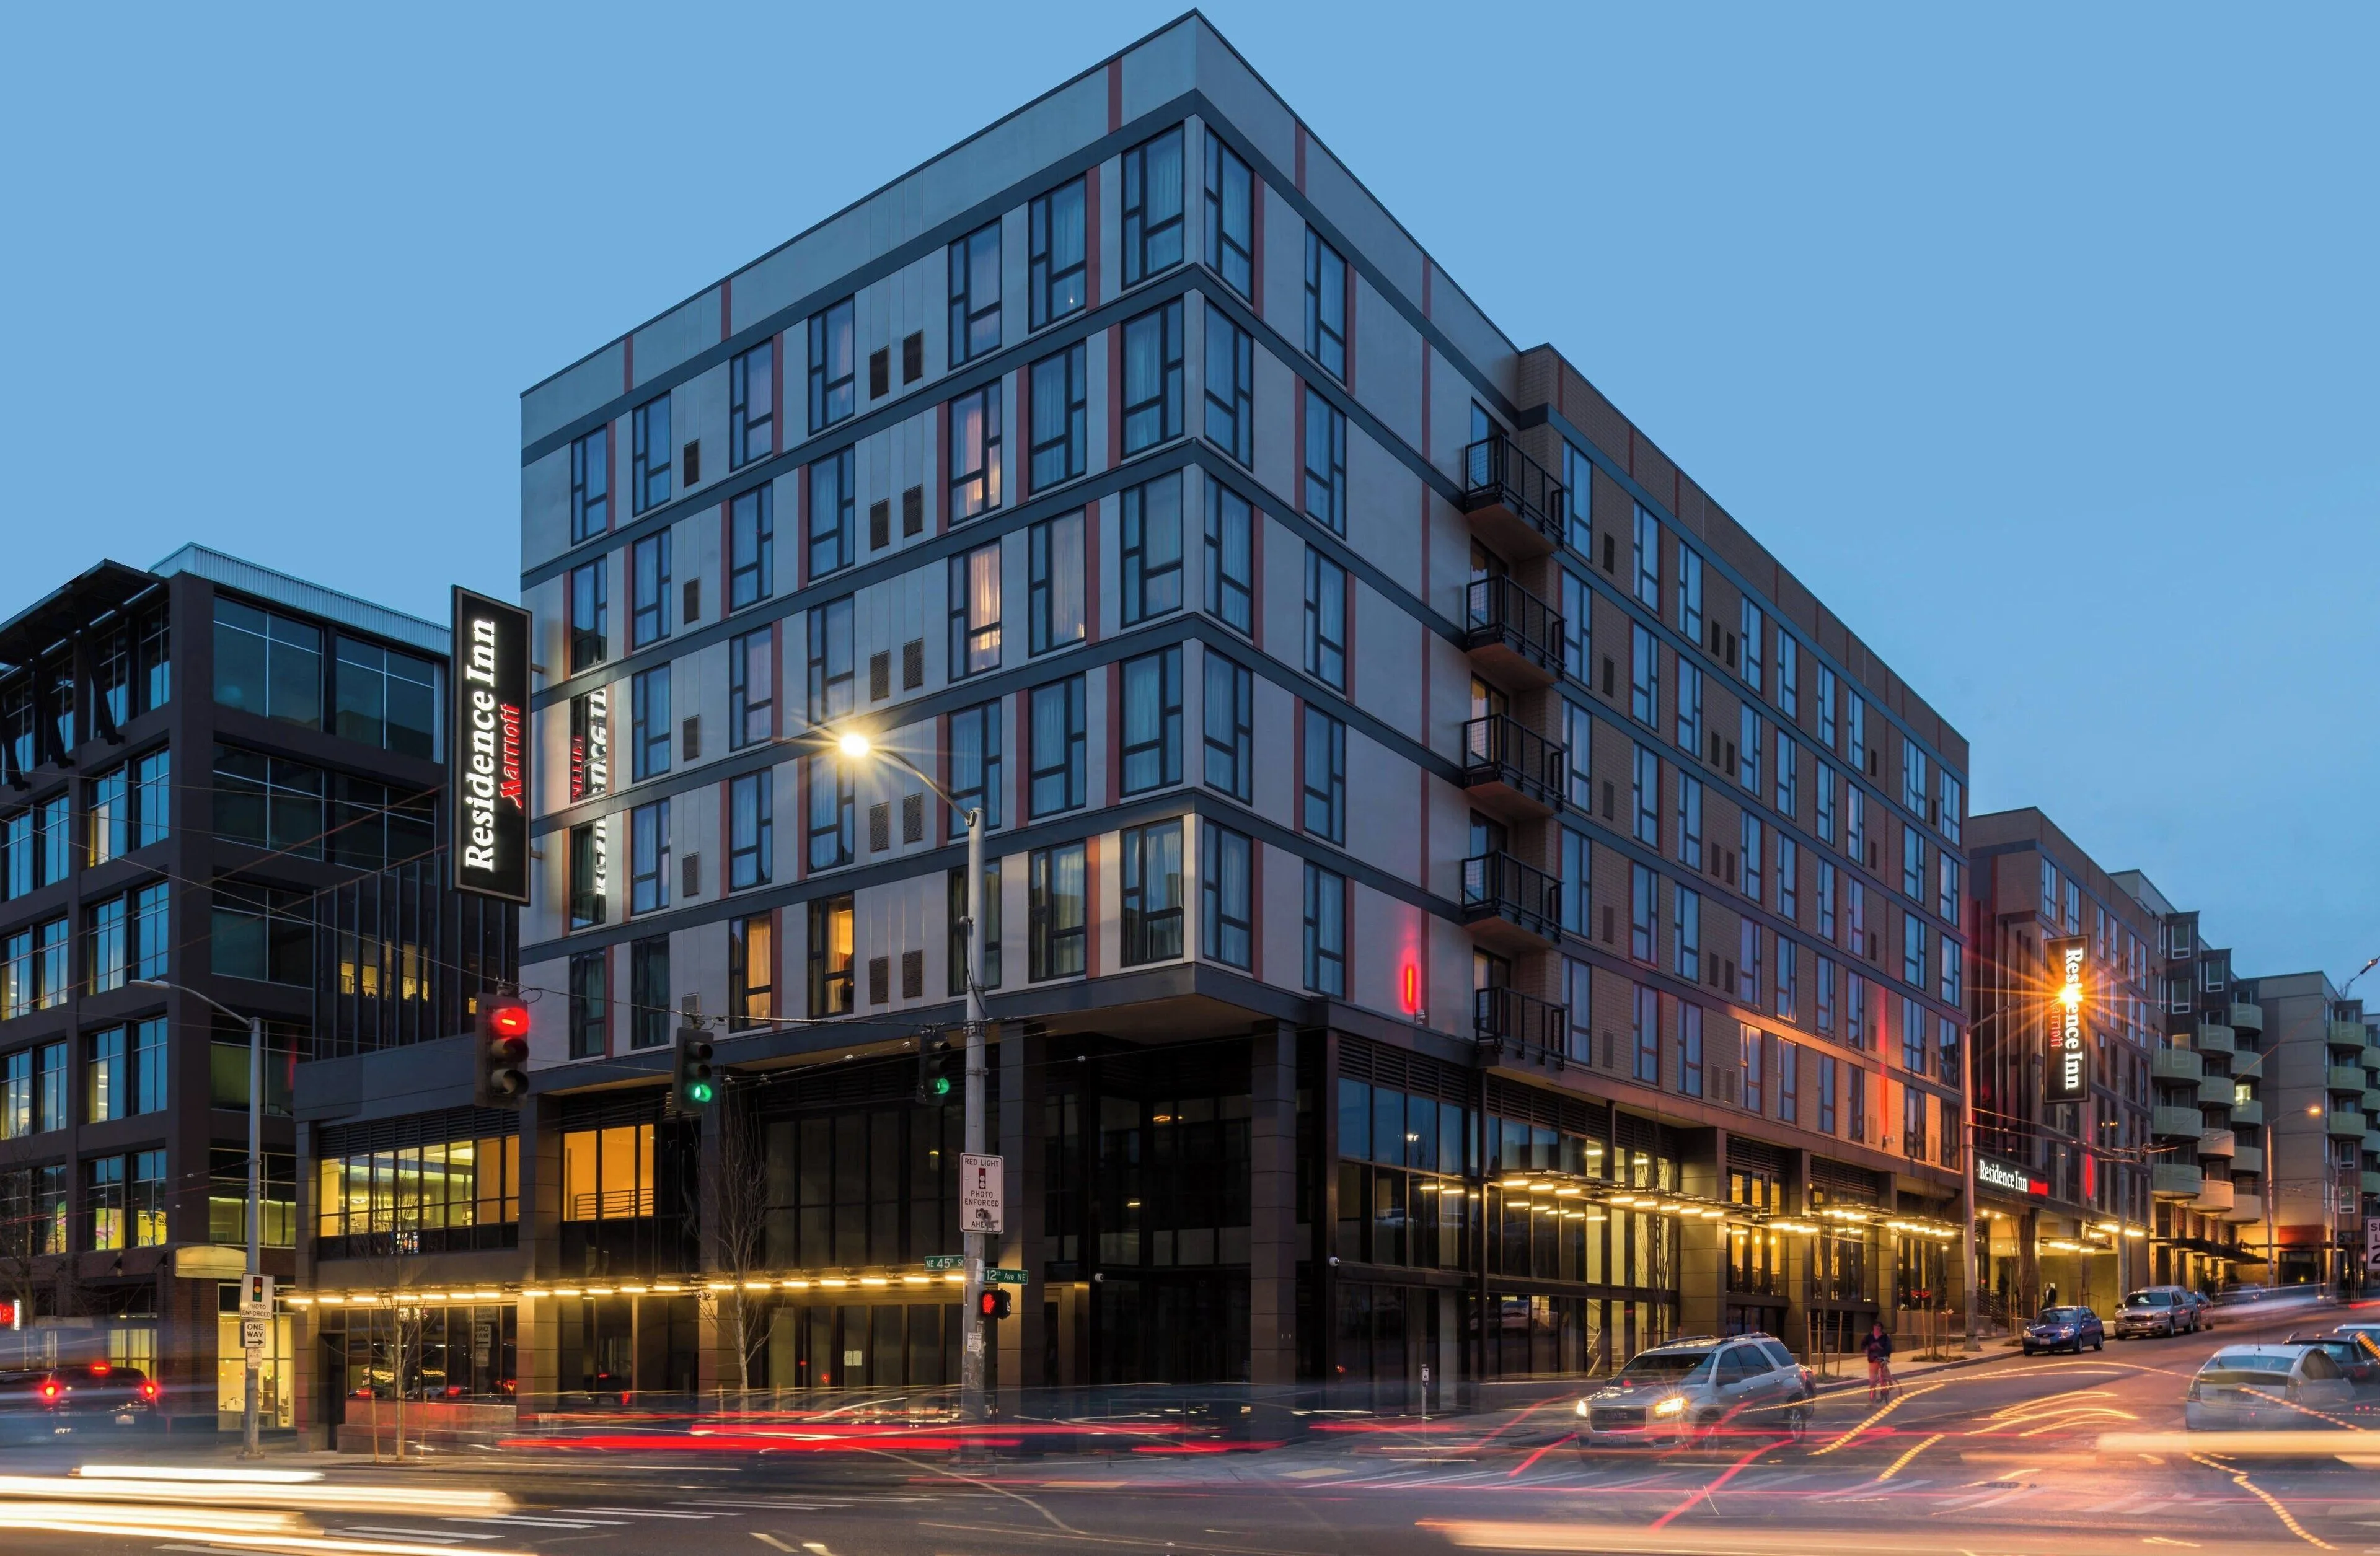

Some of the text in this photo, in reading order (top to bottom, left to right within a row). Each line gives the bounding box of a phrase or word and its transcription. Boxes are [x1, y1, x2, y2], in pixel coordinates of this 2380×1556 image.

[465, 618, 496, 872] Residence Inn
[500, 702, 522, 809] Marriott
[2065, 947, 2083, 1091] Resence Inn
[964, 1158, 977, 1166] RED
[1979, 1159, 2014, 1189] Residence
[2014, 1171, 2028, 1192] Inn
[971, 1190, 994, 1198] PHOTO
[964, 1198, 1000, 1207] ENFORCED
[971, 1221, 994, 1229] AHE
[2371, 1223, 2380, 1231] S
[925, 1260, 934, 1268] NE
[936, 1257, 954, 1269] 45th
[1017, 1273, 1026, 1281] NE
